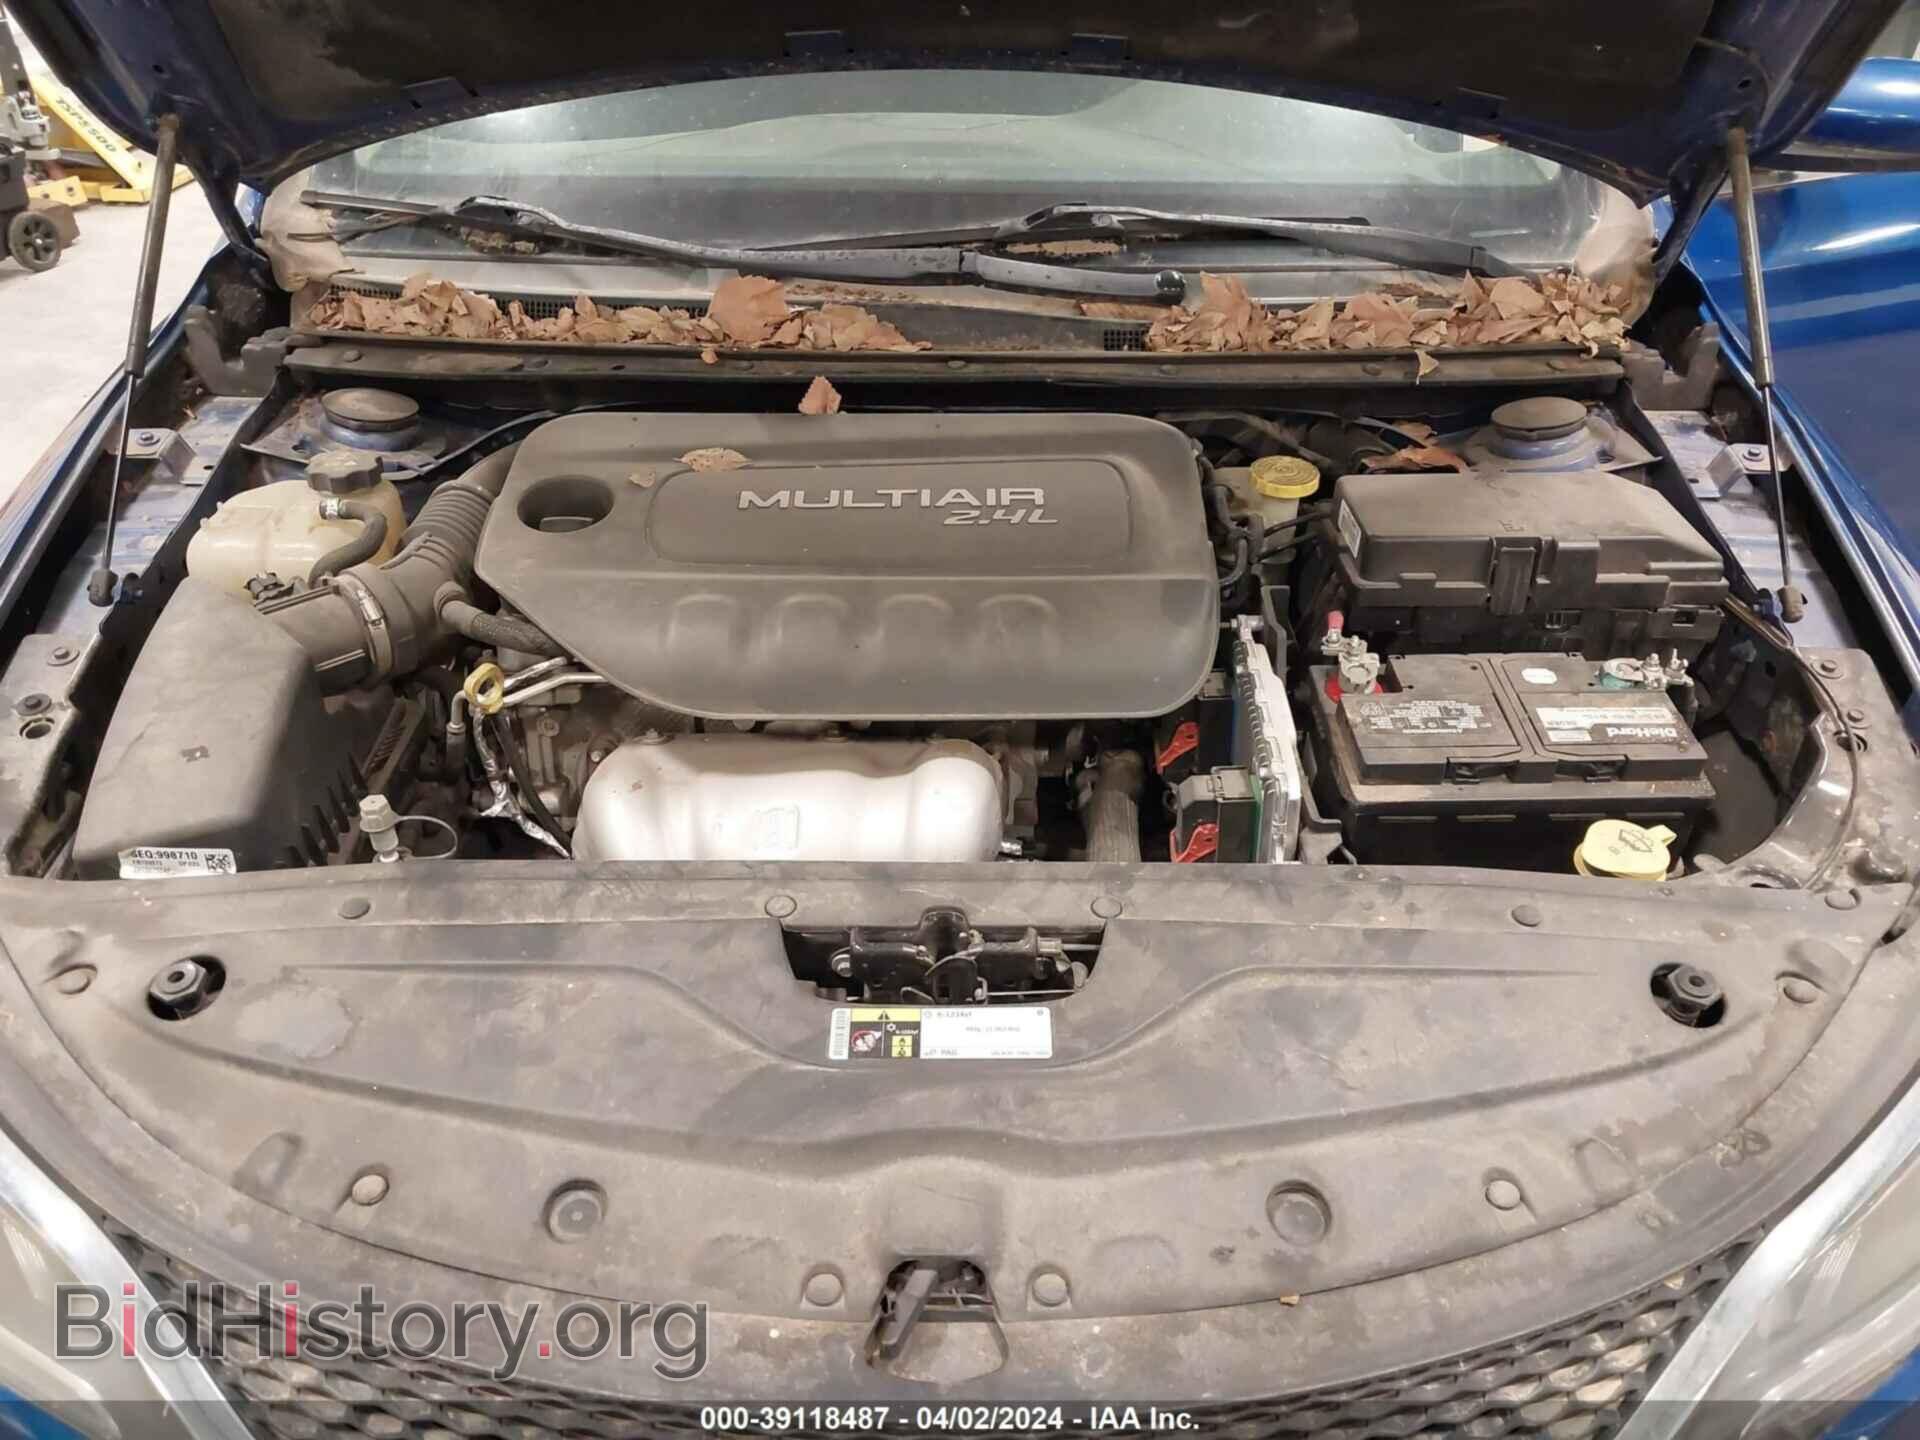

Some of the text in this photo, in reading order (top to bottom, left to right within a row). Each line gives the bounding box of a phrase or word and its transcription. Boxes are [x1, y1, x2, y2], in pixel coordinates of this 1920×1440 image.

[738, 488, 1046, 509] MULTIAIR
[943, 509, 1058, 525] 2.4L
[1605, 726, 1678, 738] DieHard
